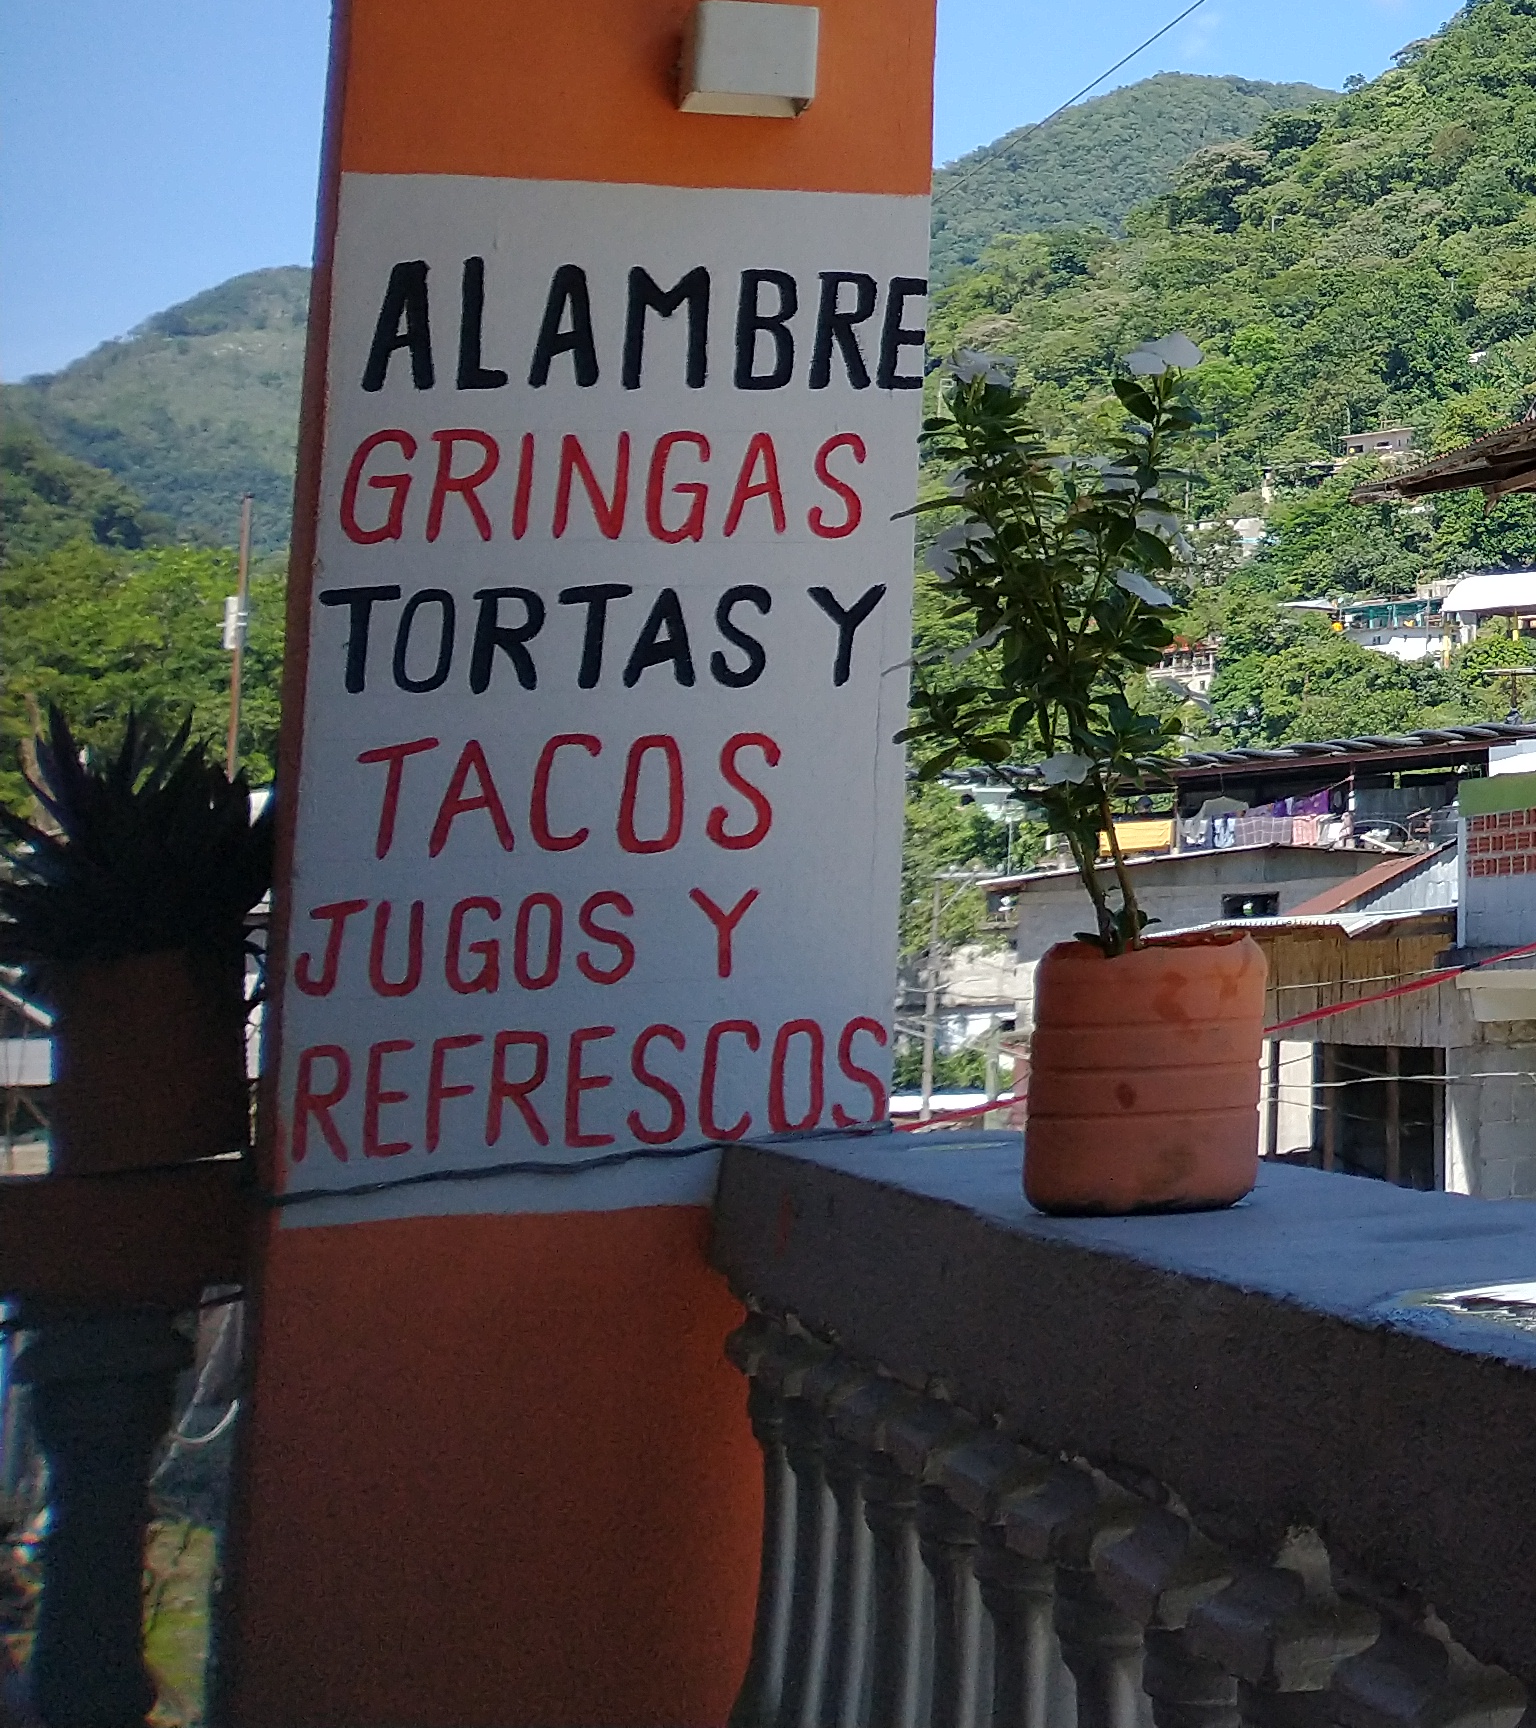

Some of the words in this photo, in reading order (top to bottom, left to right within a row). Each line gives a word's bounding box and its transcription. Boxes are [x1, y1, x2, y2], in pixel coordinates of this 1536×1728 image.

[361, 255, 927, 393] ALAMBRE
[339, 427, 865, 545] GRINGAS
[319, 583, 771, 694] TORTAS
[807, 583, 887, 688] Y
[358, 731, 782, 860] TACOS
[294, 889, 635, 997] JUGOS
[689, 885, 760, 978] Y
[291, 1015, 888, 1163] REFRESCOS
